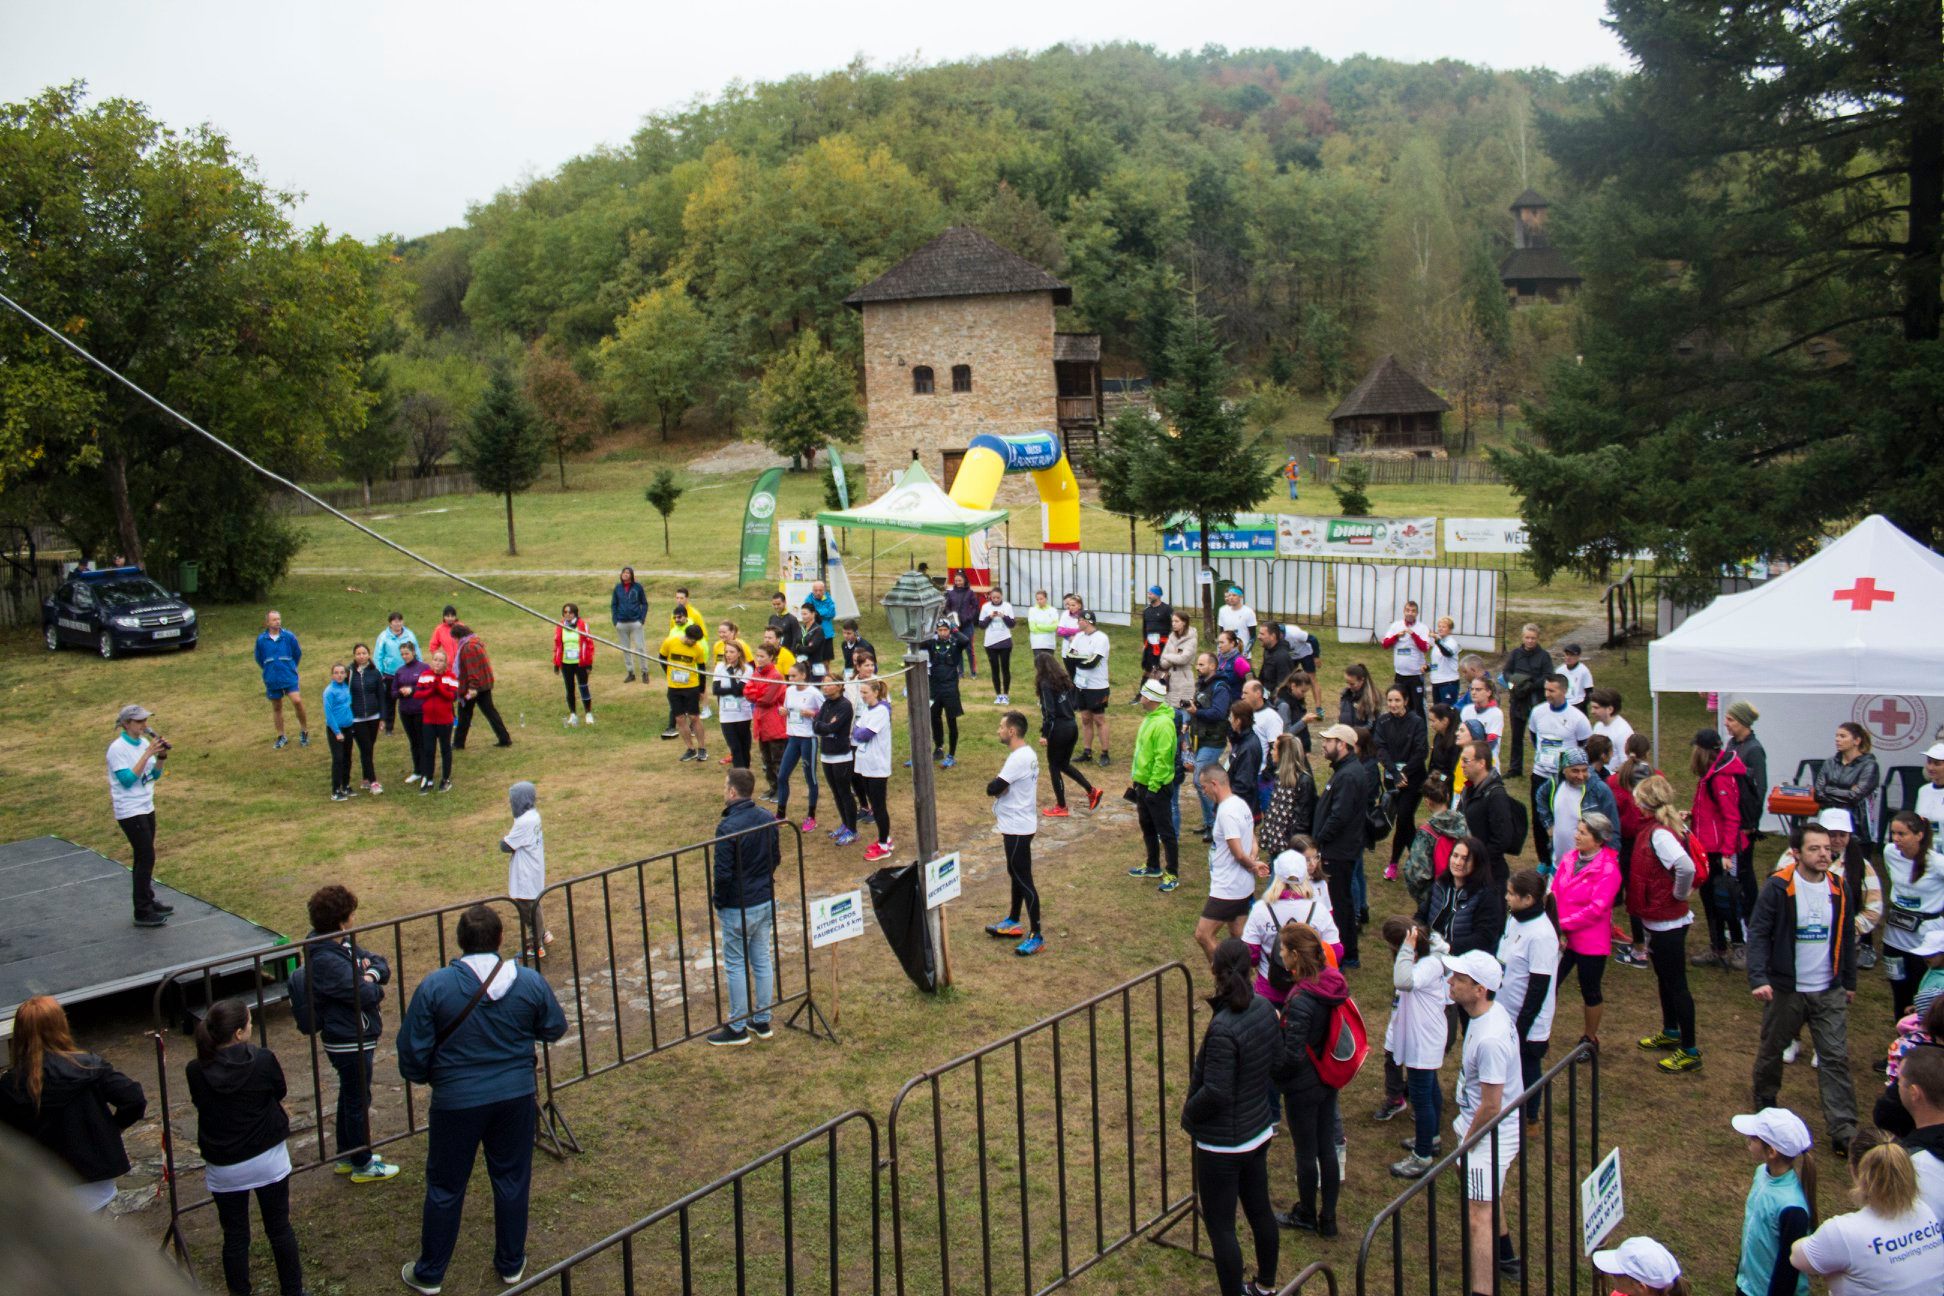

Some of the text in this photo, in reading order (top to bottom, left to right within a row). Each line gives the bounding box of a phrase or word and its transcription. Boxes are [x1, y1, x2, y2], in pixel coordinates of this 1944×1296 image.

[1333, 525, 1372, 538] DIANA
[1229, 541, 1249, 549] RUN
[928, 875, 959, 899] SECRETARIAT
[816, 910, 856, 931] KITURI CROS
